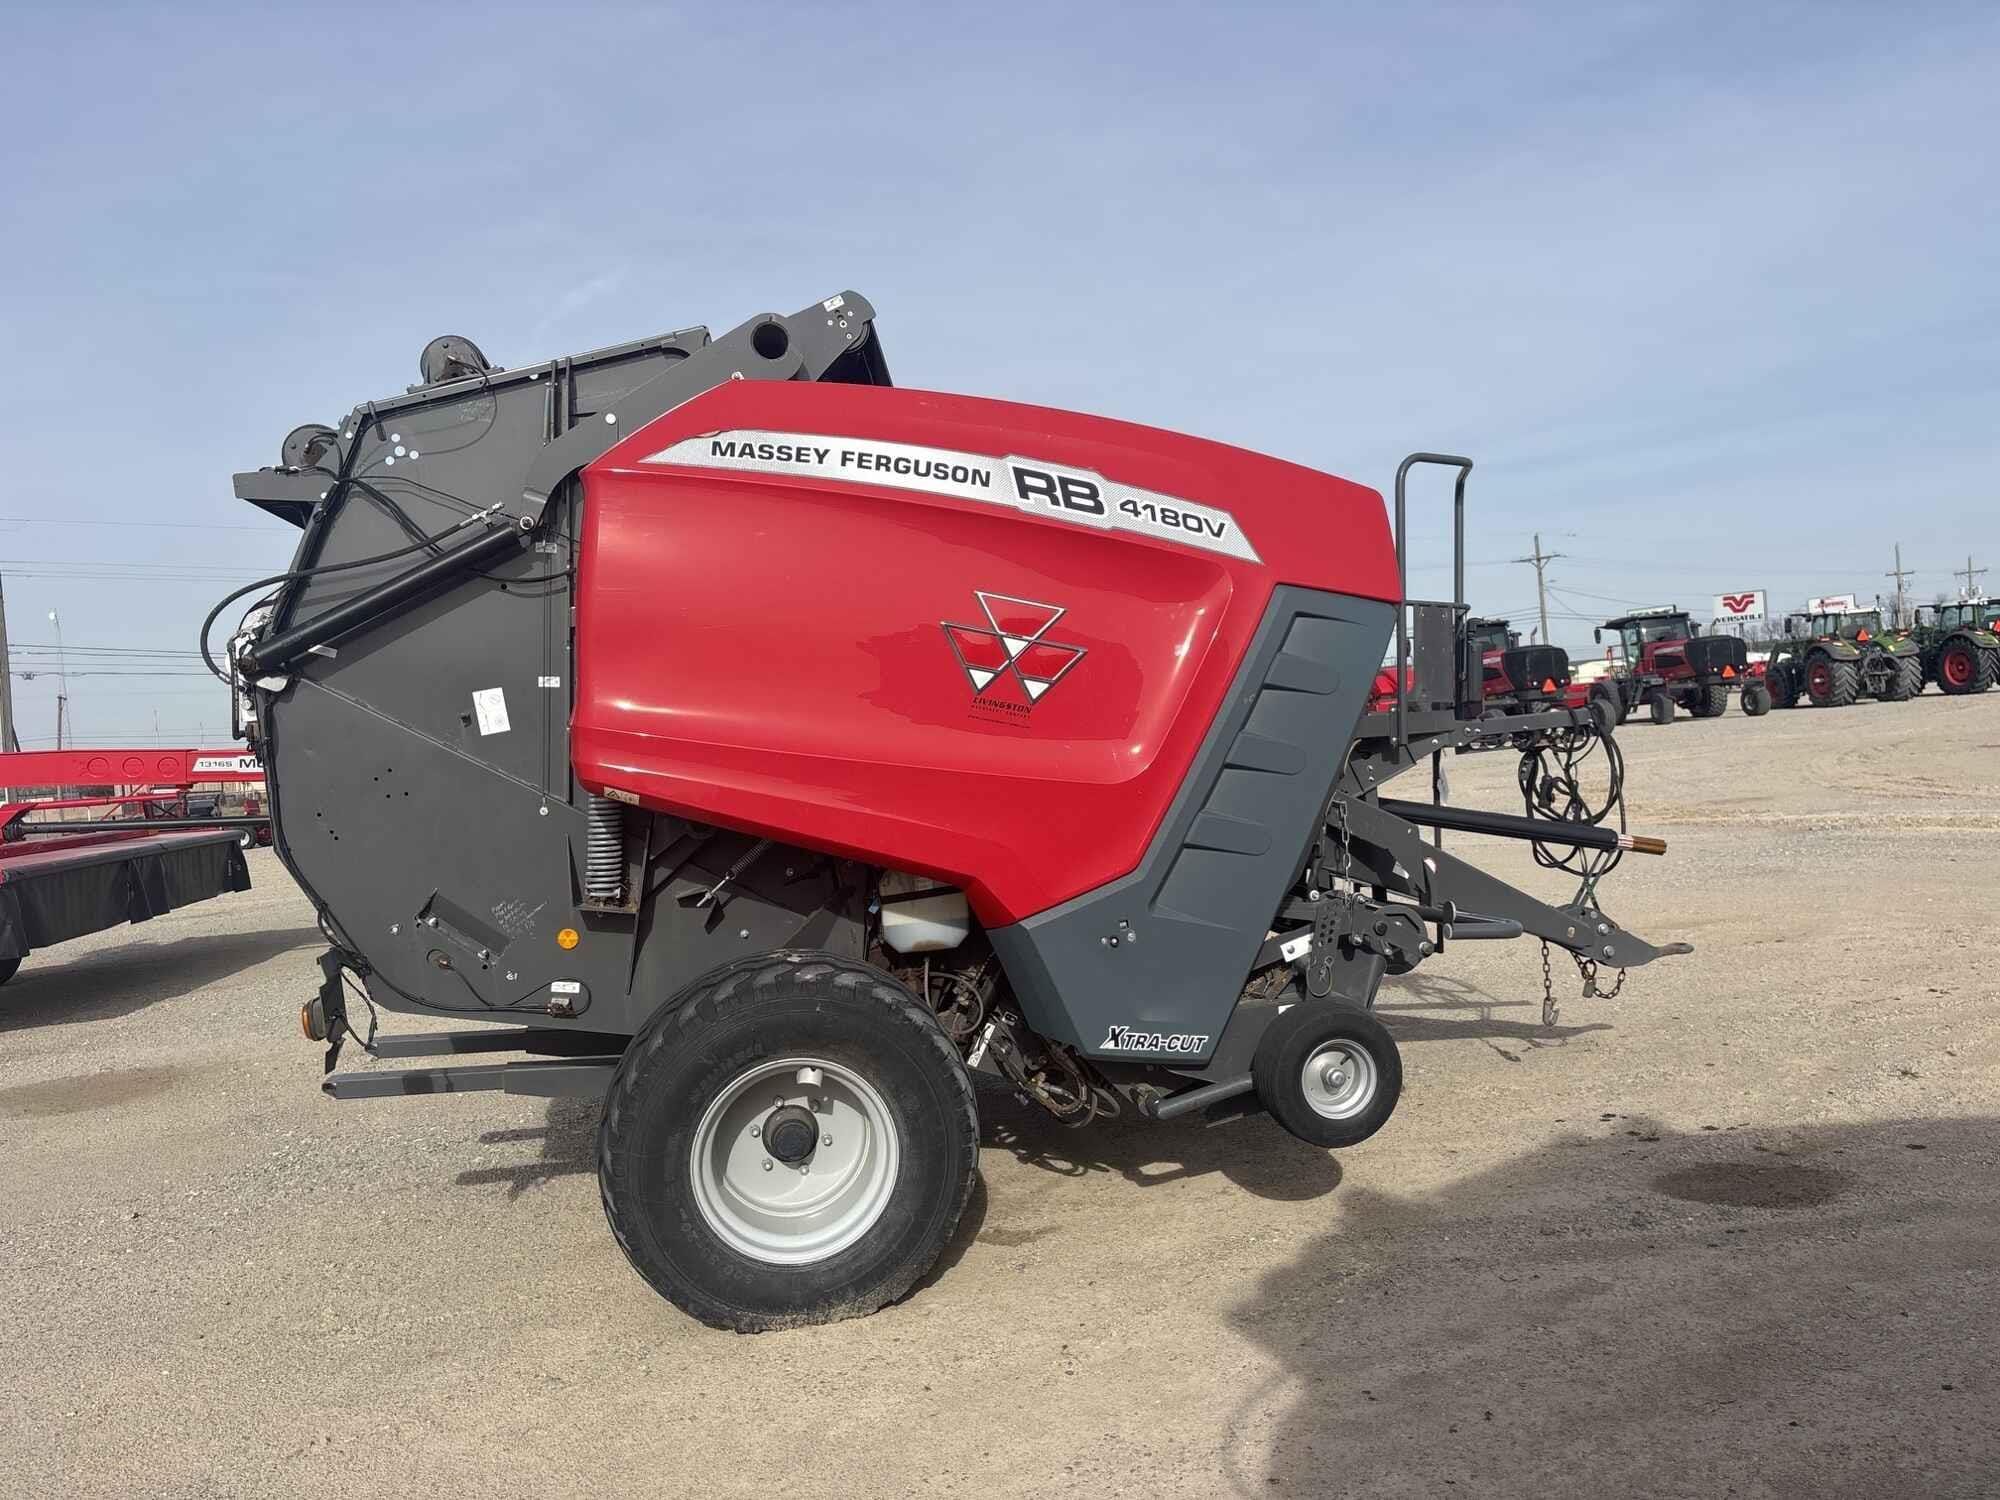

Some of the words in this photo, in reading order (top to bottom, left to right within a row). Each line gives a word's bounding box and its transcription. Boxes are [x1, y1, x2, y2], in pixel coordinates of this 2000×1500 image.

[711, 440, 831, 465] MASSEY
[840, 450, 991, 488] FERGUSON
[1012, 466, 1105, 515] RB
[1119, 499, 1226, 538] 4180V
[973, 697, 1032, 714] LIVINGSTON
